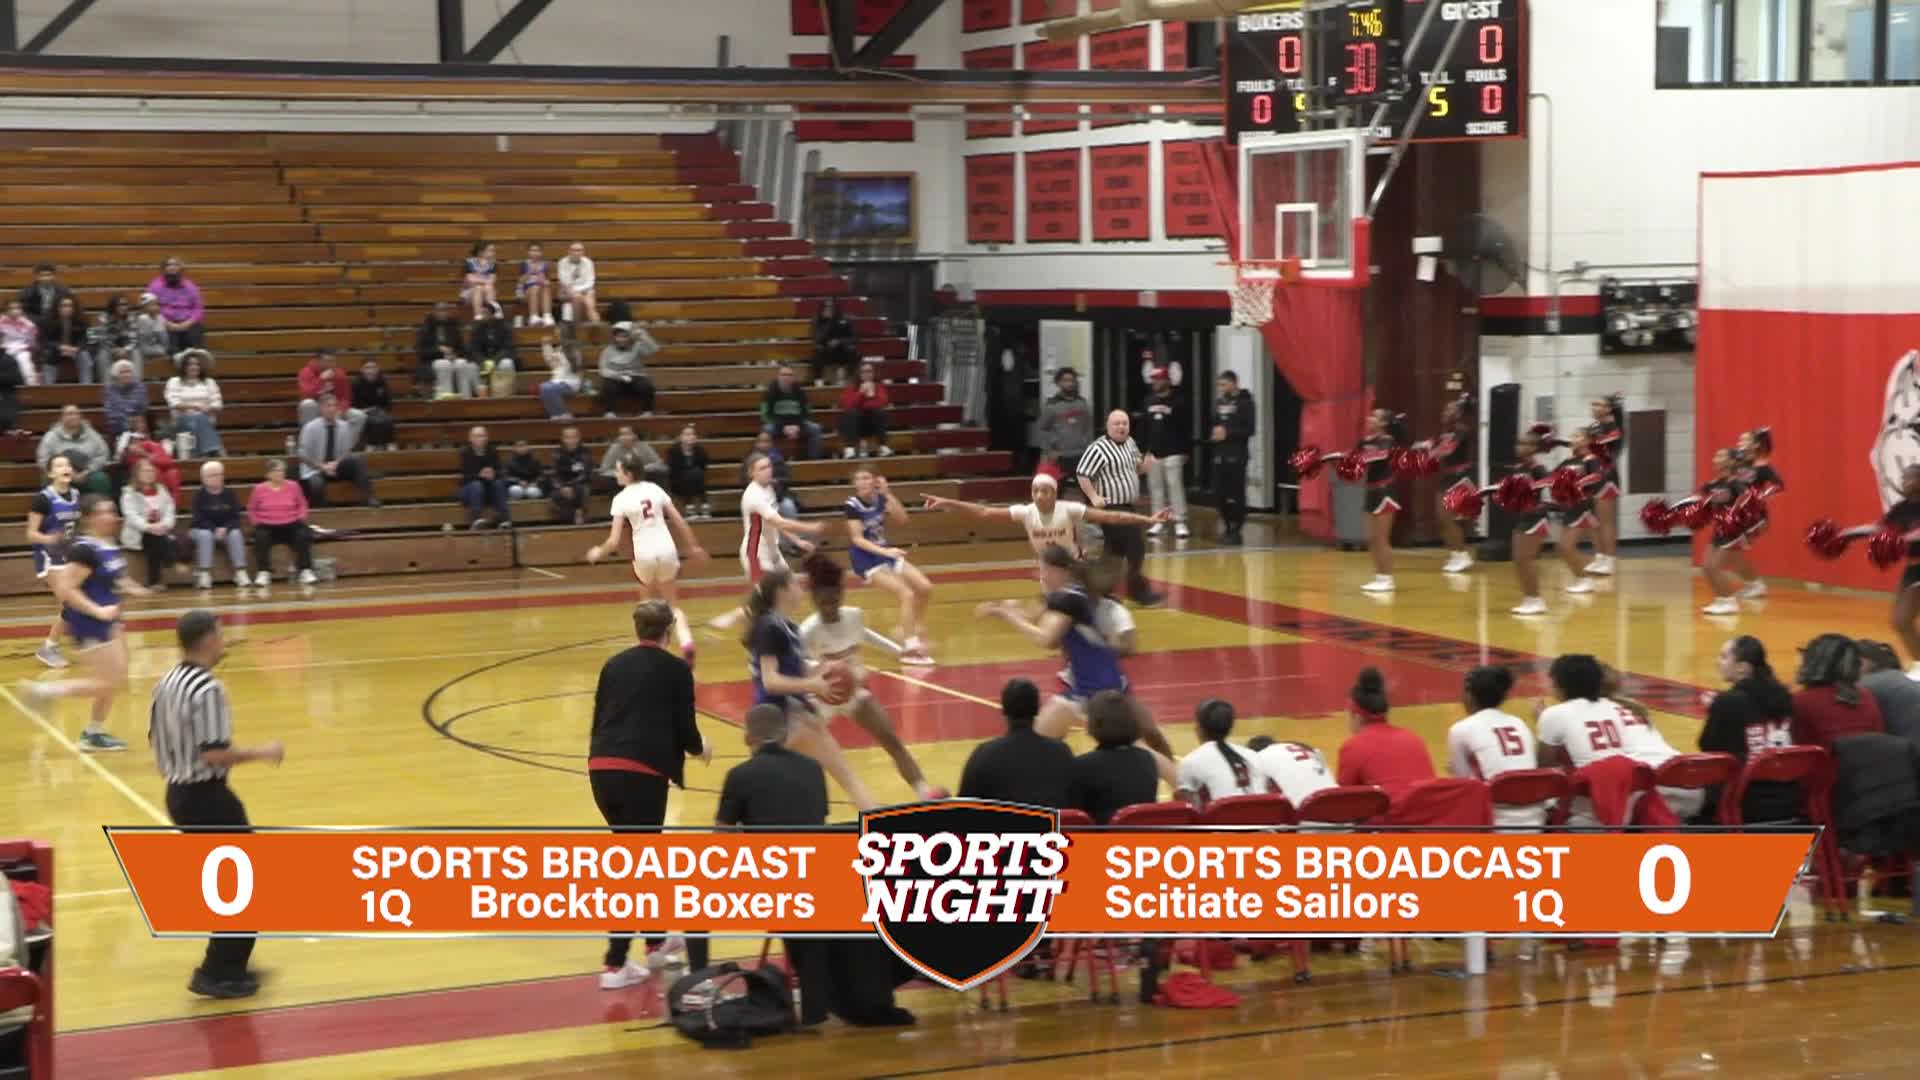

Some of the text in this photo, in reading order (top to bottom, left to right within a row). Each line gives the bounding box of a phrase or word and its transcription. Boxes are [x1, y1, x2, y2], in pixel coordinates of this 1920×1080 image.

[1279, 36, 1301, 73] 0
[1479, 25, 1502, 63] 0
[1344, 42, 1376, 95] 30
[1253, 94, 1272, 124] 0
[1428, 86, 1449, 117] 5
[1482, 85, 1502, 114] 0
[641, 499, 655, 519] 2
[1494, 726, 1525, 756] 15
[1585, 720, 1622, 751] 20
